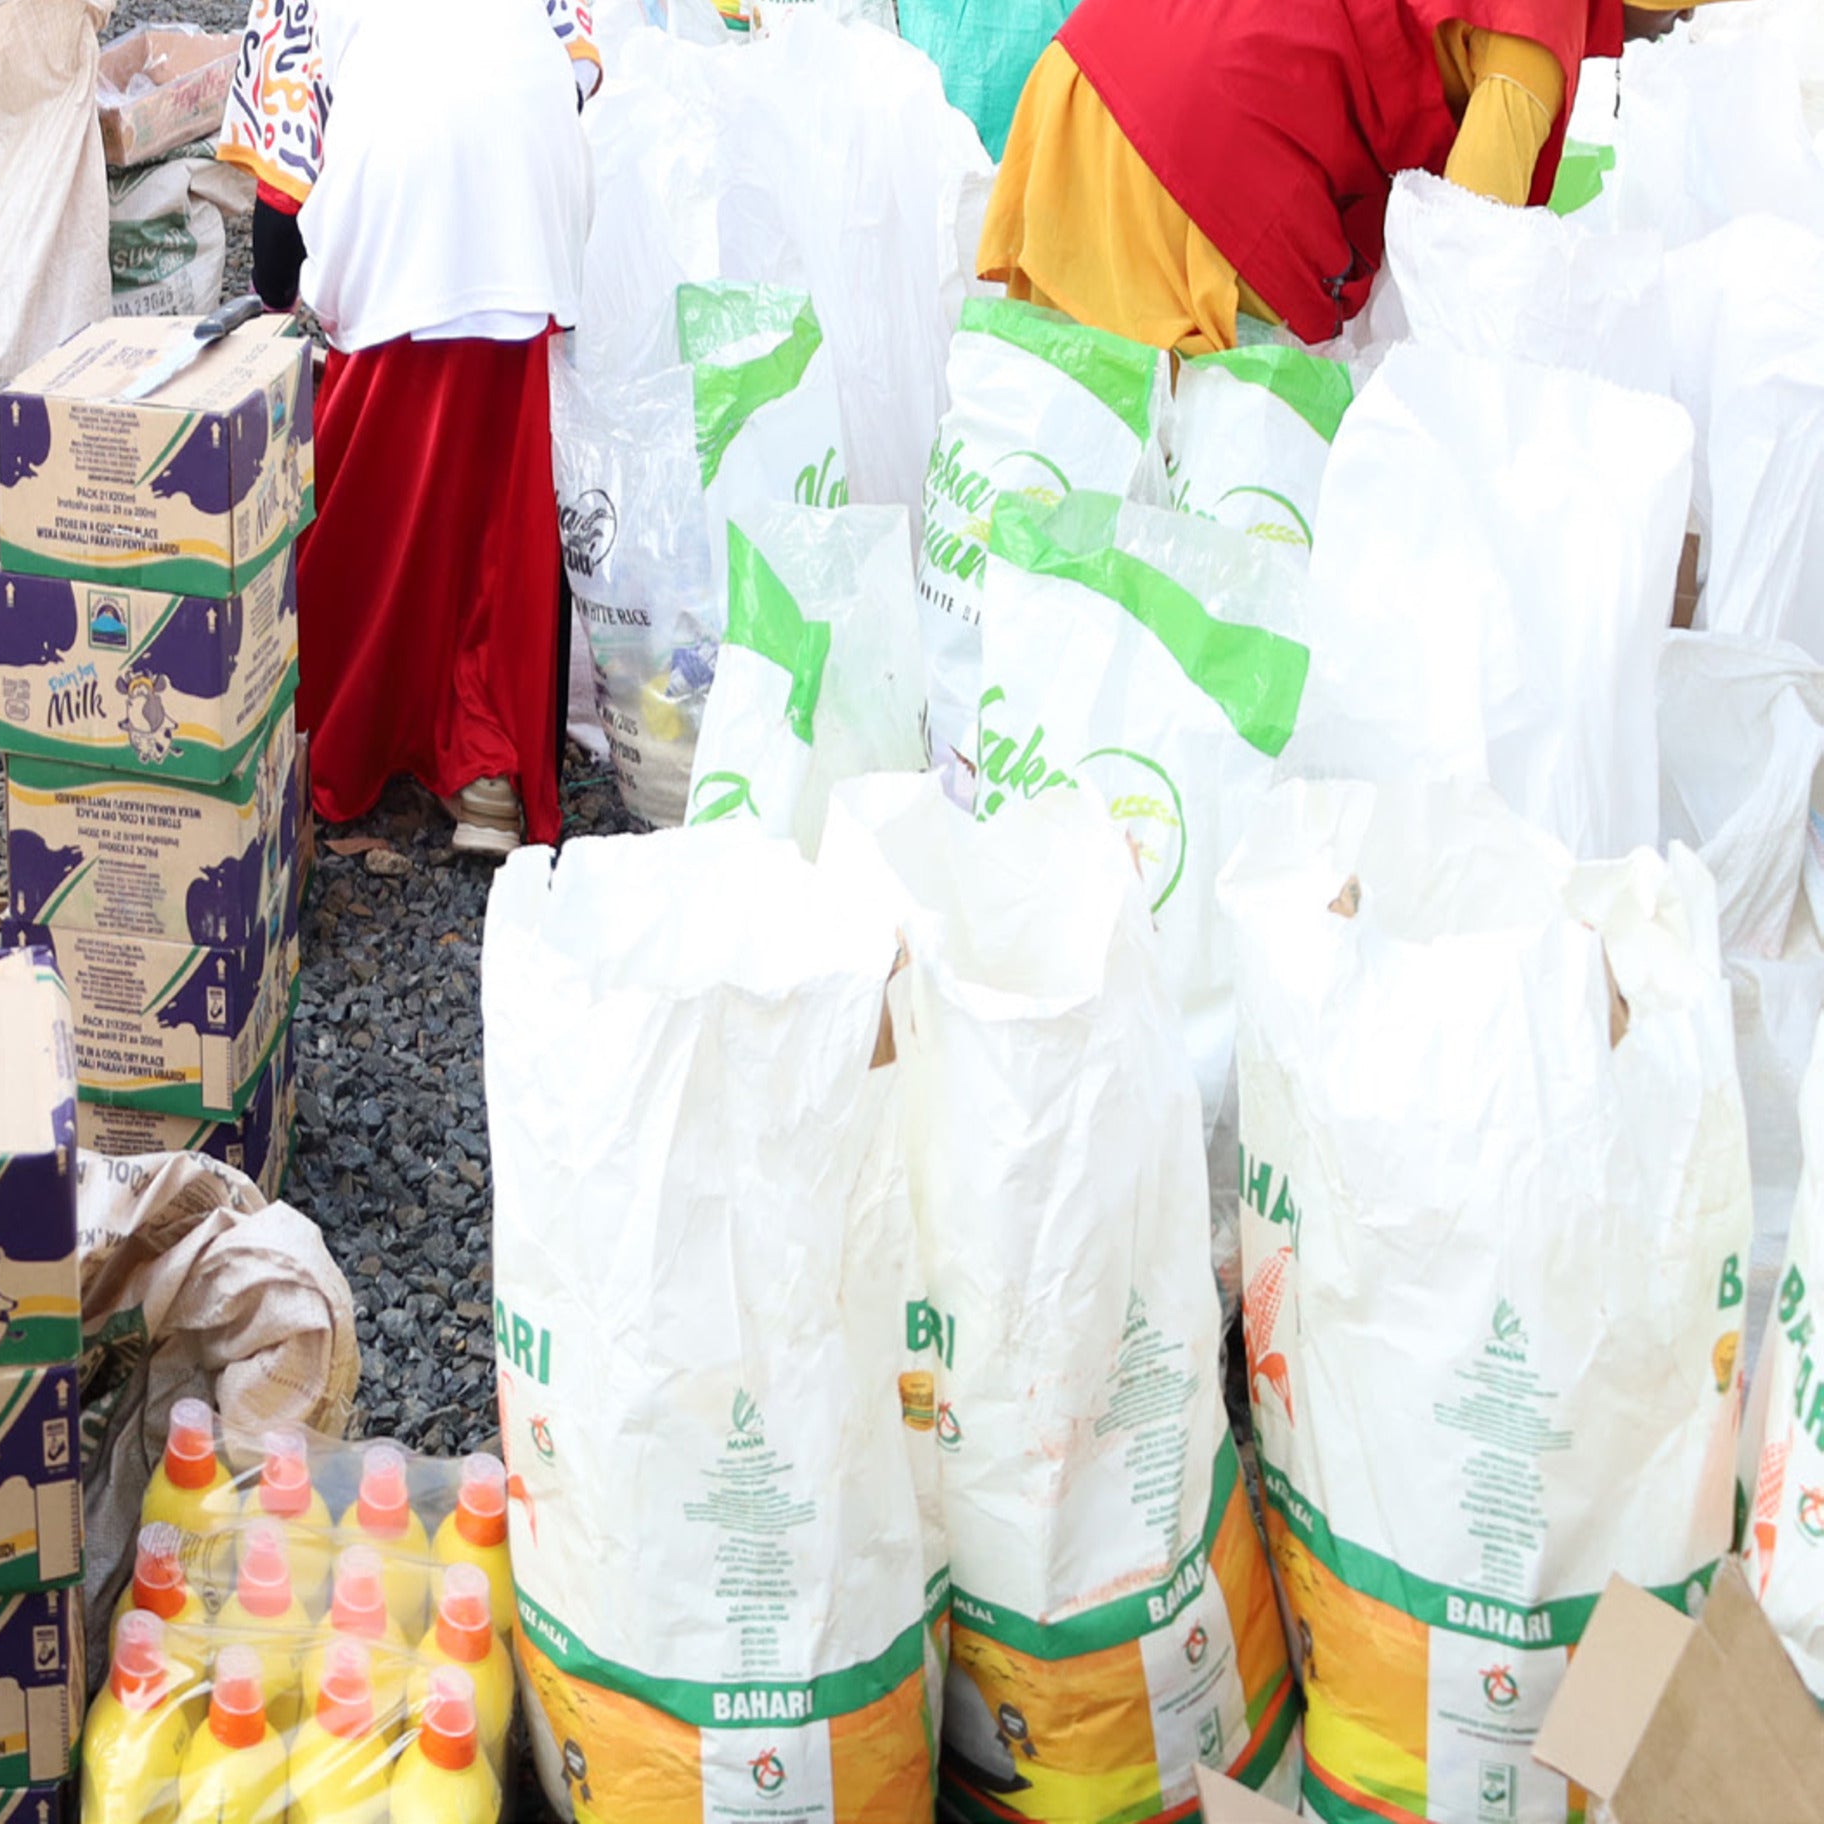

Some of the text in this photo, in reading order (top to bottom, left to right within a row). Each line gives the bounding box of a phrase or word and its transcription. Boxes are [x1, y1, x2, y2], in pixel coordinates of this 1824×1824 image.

[617, 606, 651, 627] RICE
[47, 679, 107, 728] Milk
[727, 1435, 766, 1452] MMM
[537, 1612, 571, 1656] MEAL
[1446, 1594, 1553, 1643] BAHARI
[712, 1689, 814, 1721] BAHARI
